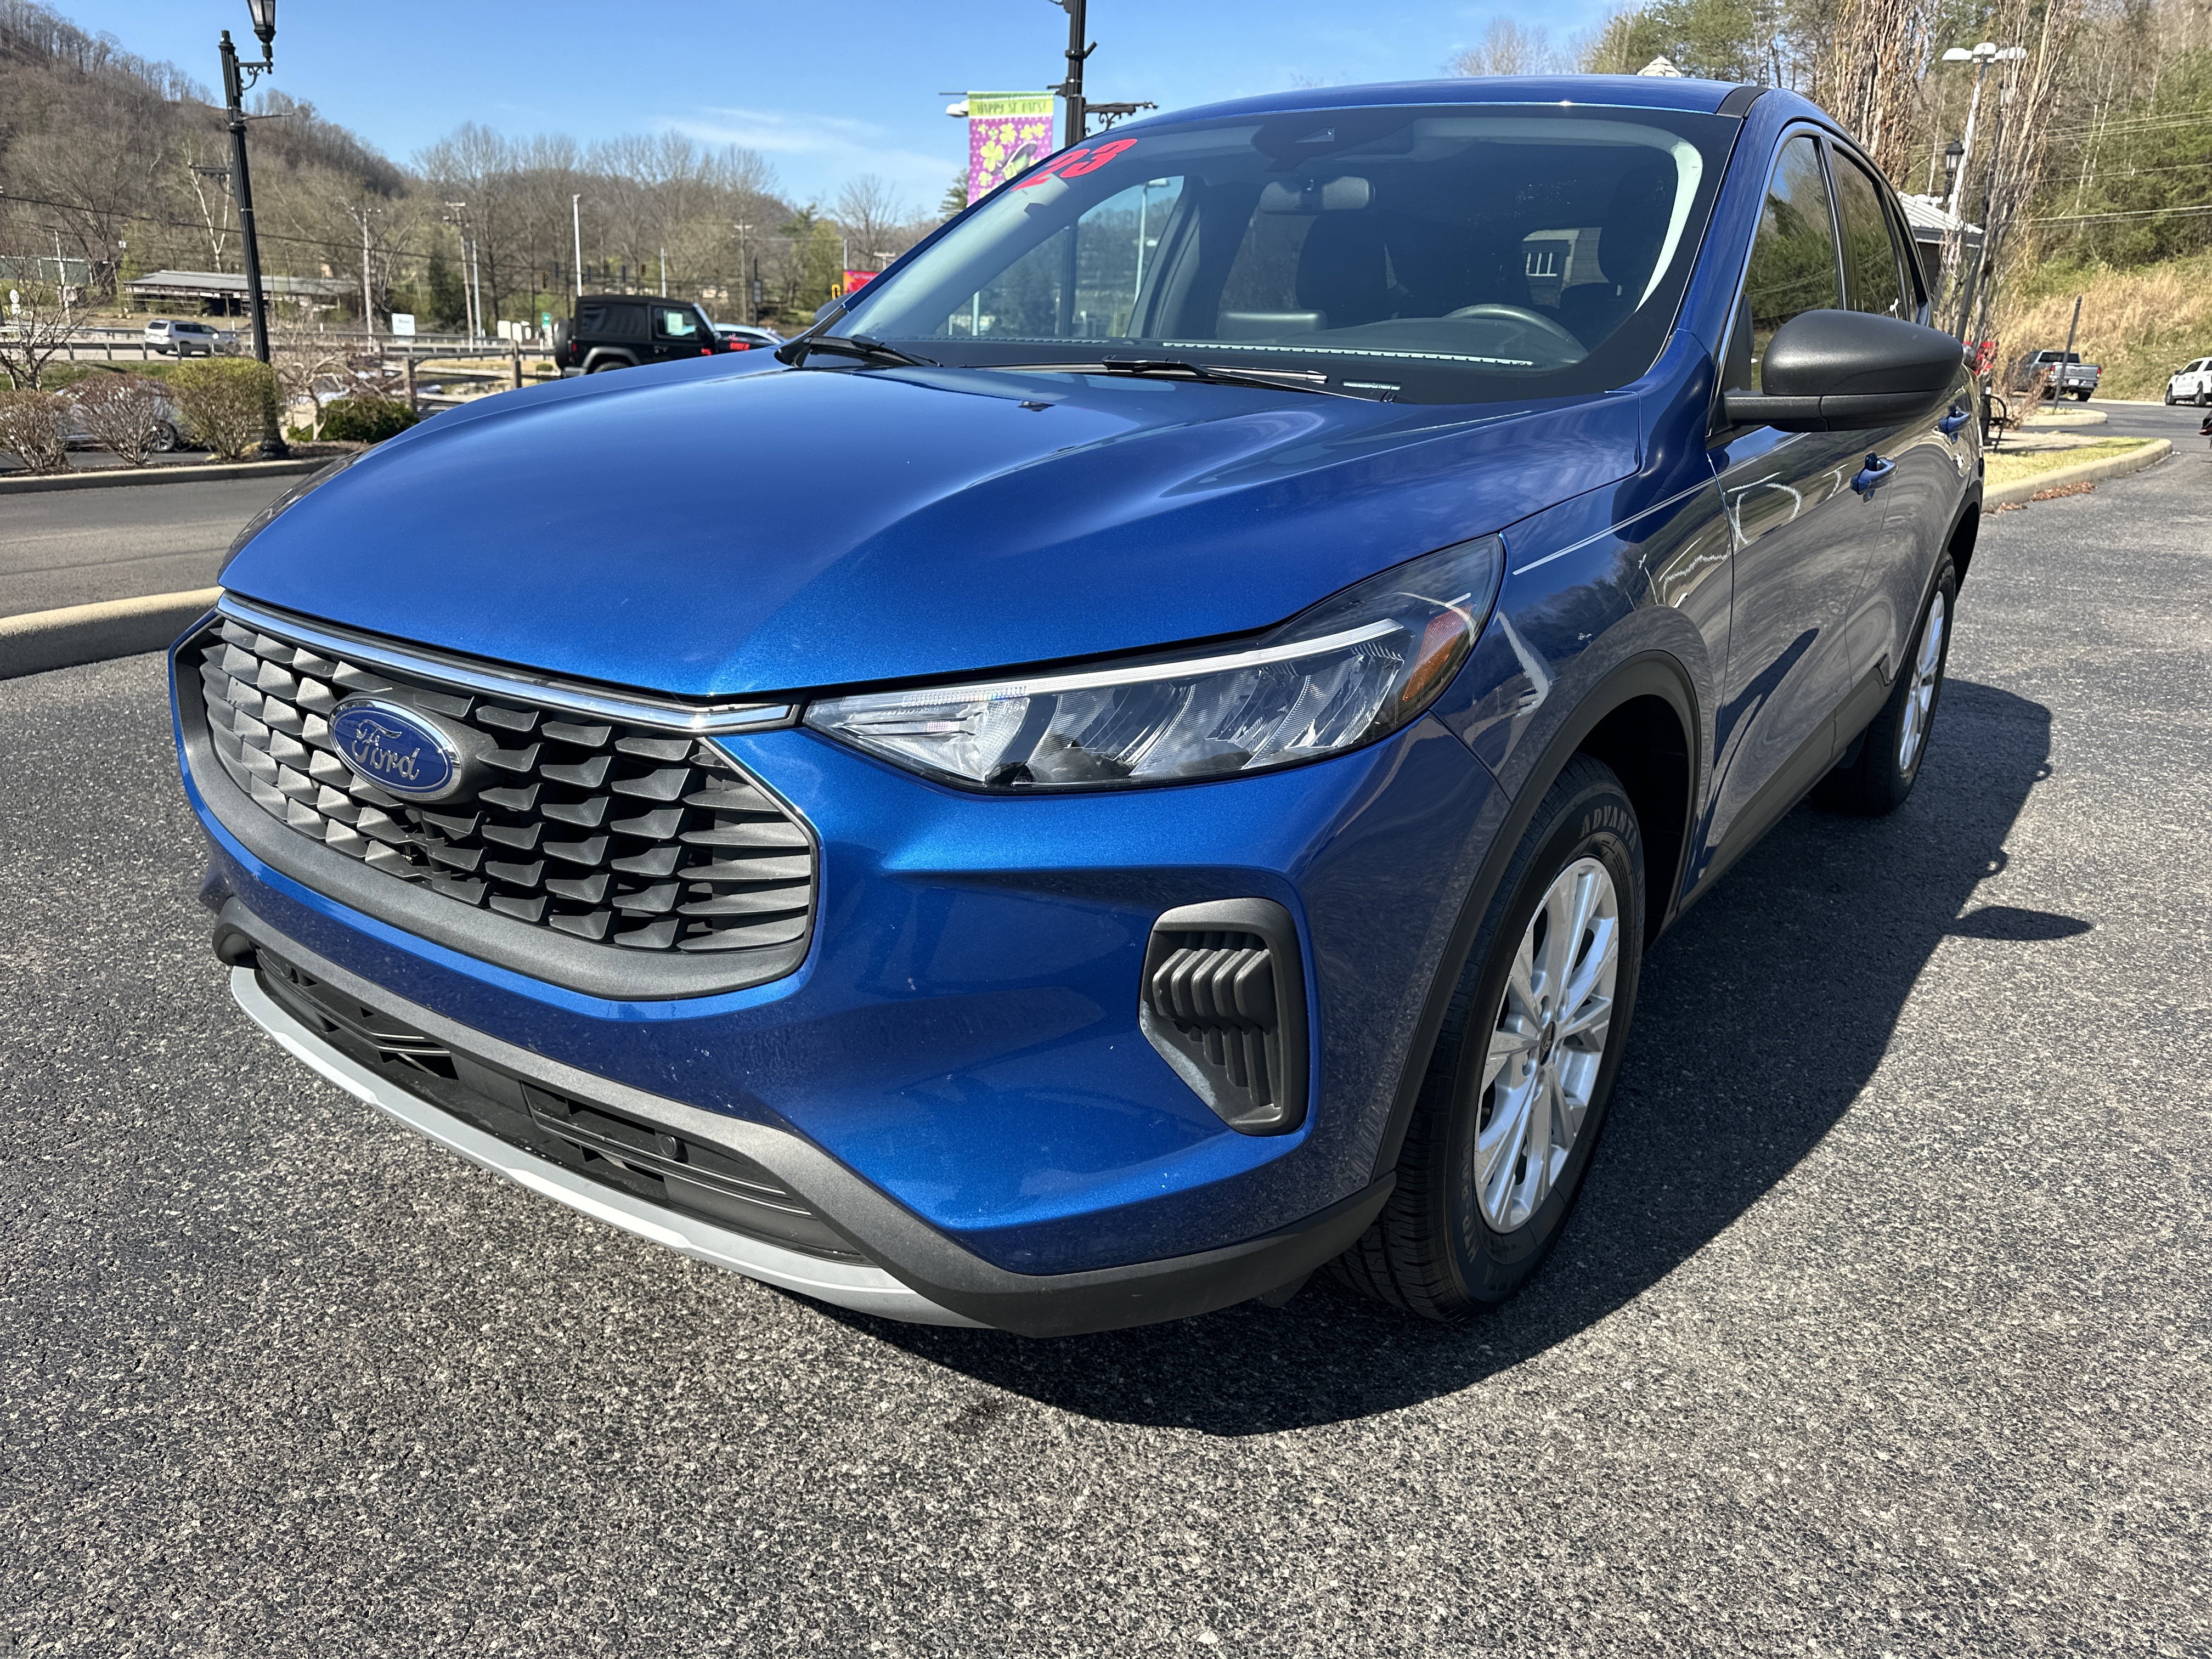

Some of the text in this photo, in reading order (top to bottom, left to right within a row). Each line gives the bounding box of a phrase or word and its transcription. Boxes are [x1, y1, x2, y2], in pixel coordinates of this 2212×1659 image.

[977, 102, 1004, 114] HAPPY
[1010, 138, 1137, 192] 23
[352, 719, 420, 780] Ford
[1579, 805, 1637, 853] ADVANTA
